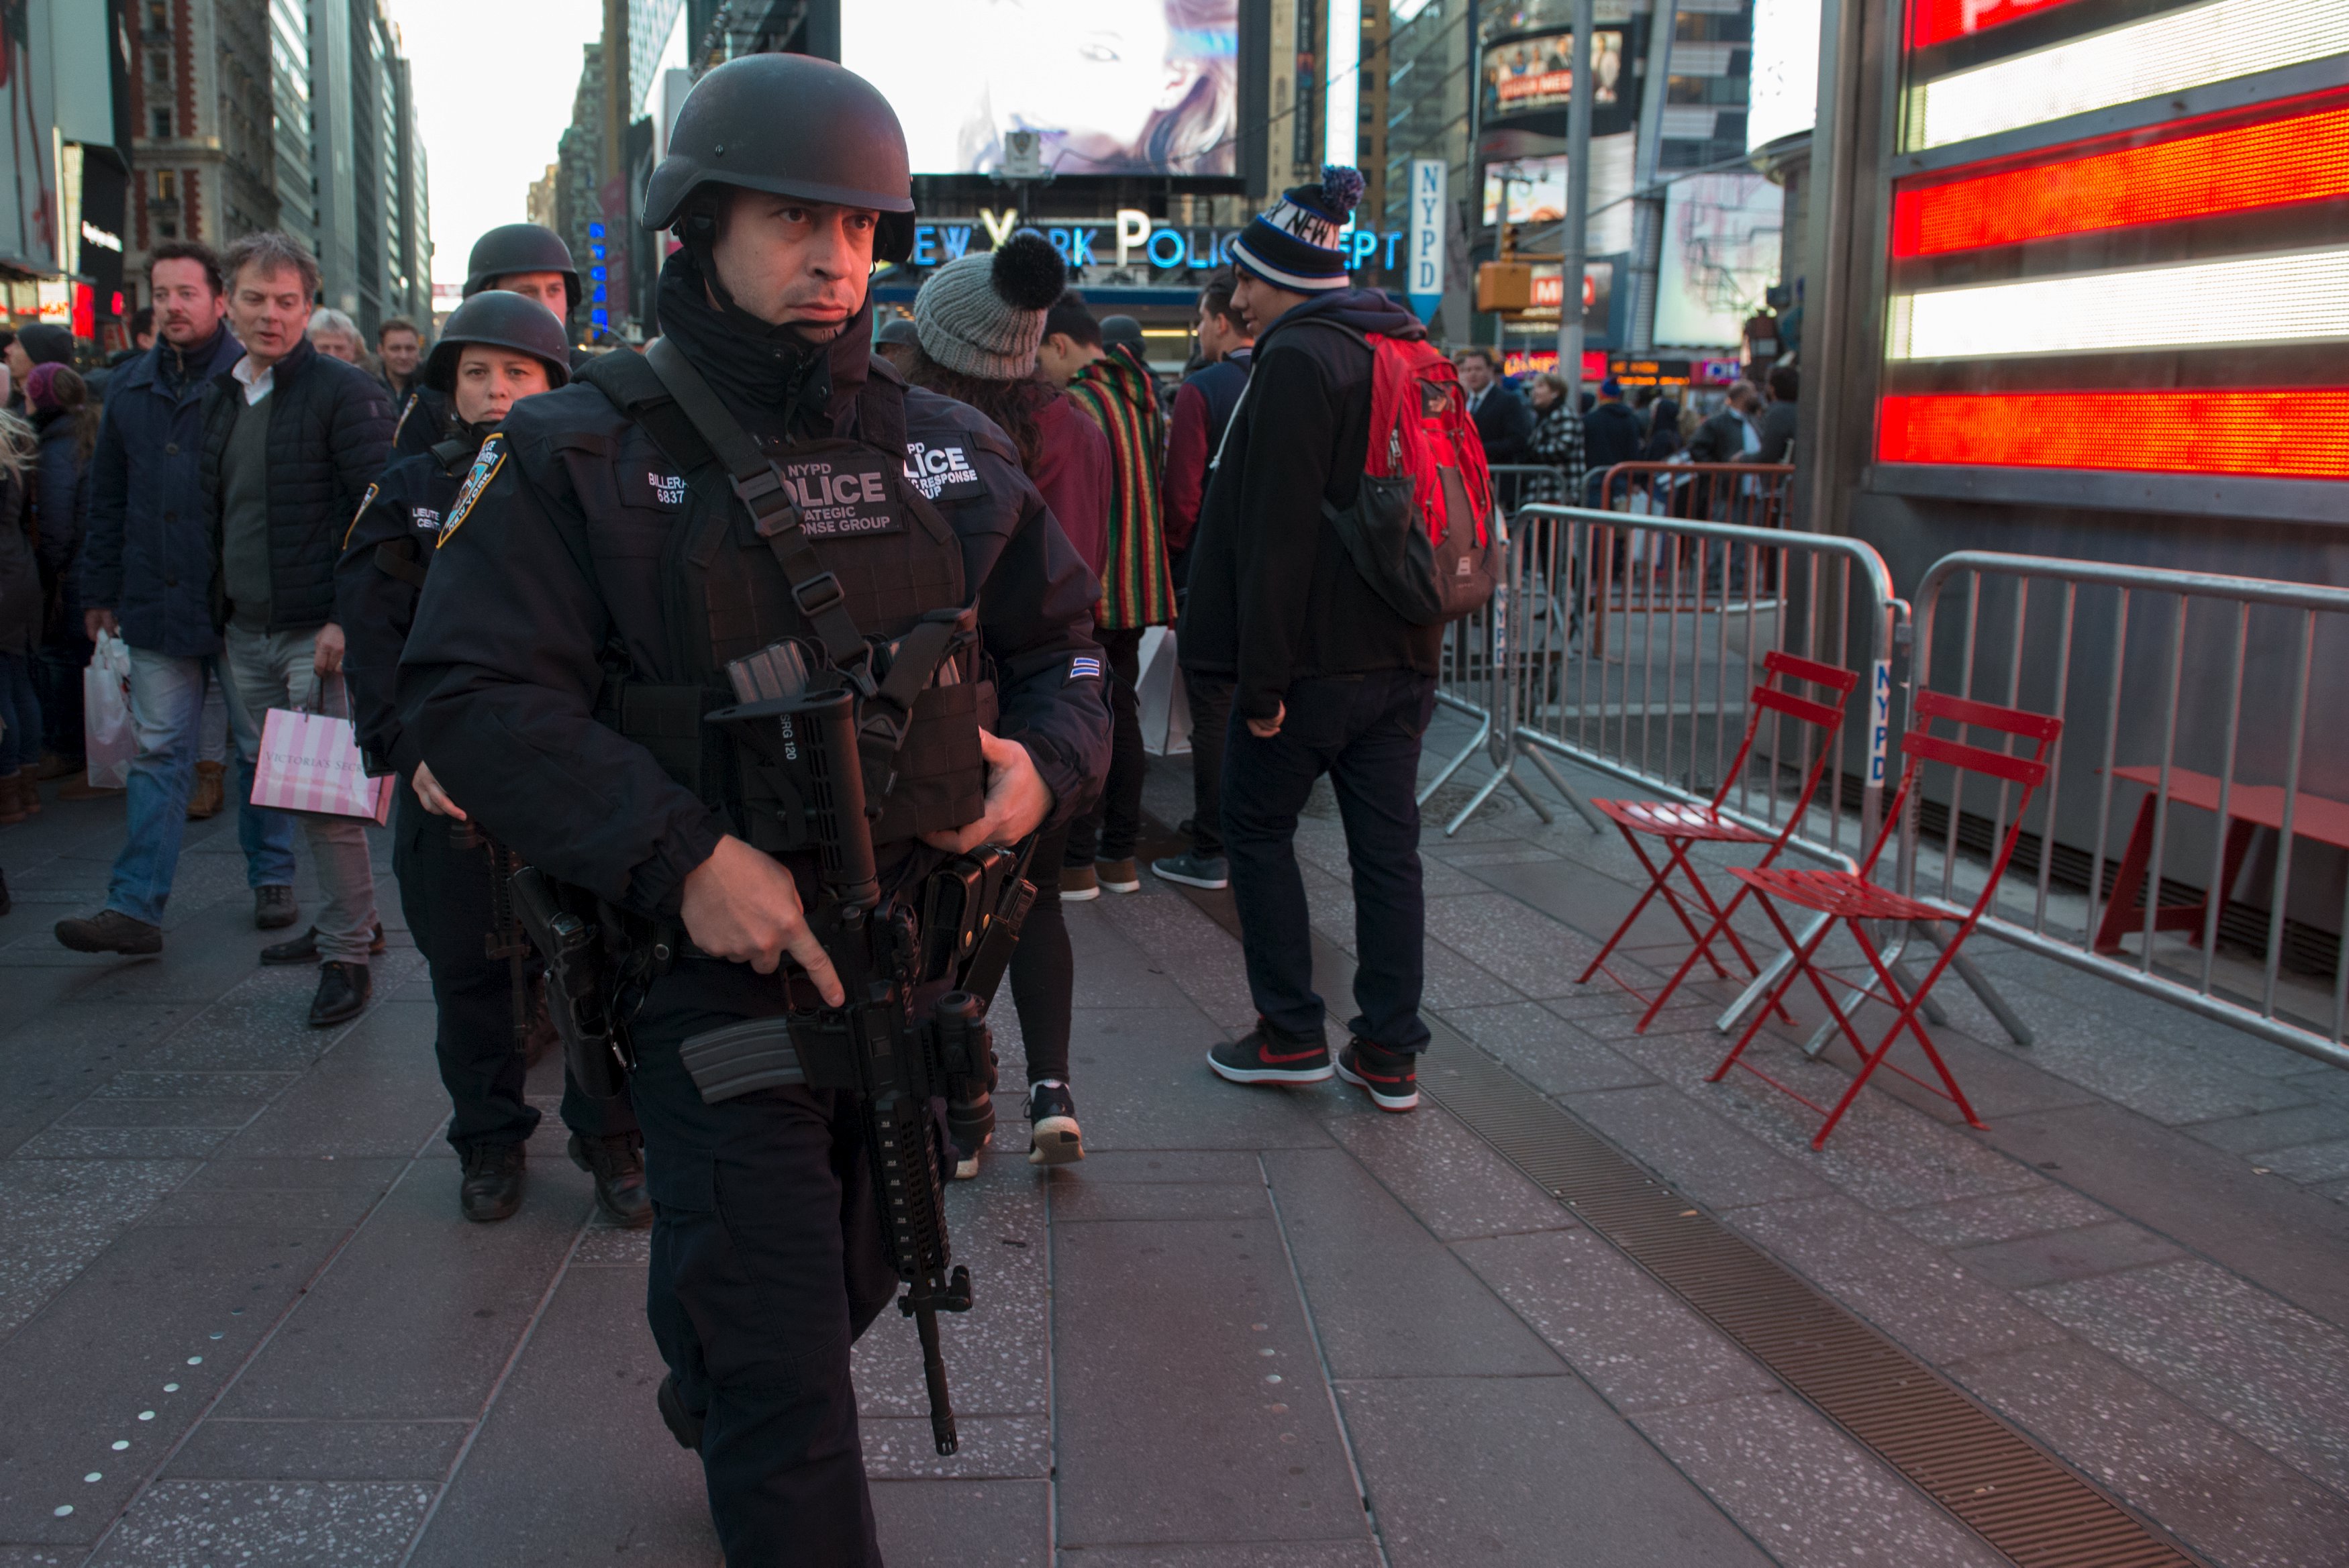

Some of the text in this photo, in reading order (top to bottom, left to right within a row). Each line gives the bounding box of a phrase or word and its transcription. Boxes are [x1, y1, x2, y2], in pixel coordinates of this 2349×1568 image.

[1285, 208, 1331, 248] NEW
[1420, 165, 1439, 289] NYPD
[788, 463, 832, 477] NYPD
[919, 469, 978, 490] RESPONSE
[448, 472, 491, 531] NEW YORK
[657, 489, 684, 503] 6837
[919, 485, 942, 500] UP
[805, 506, 856, 521] ATEGIC
[417, 519, 441, 531] CENT
[839, 516, 891, 533] GROUP
[1872, 664, 1891, 780] NYPD
[780, 714, 797, 760] SRG 120
[266, 751, 330, 769] VICTORIA'S
